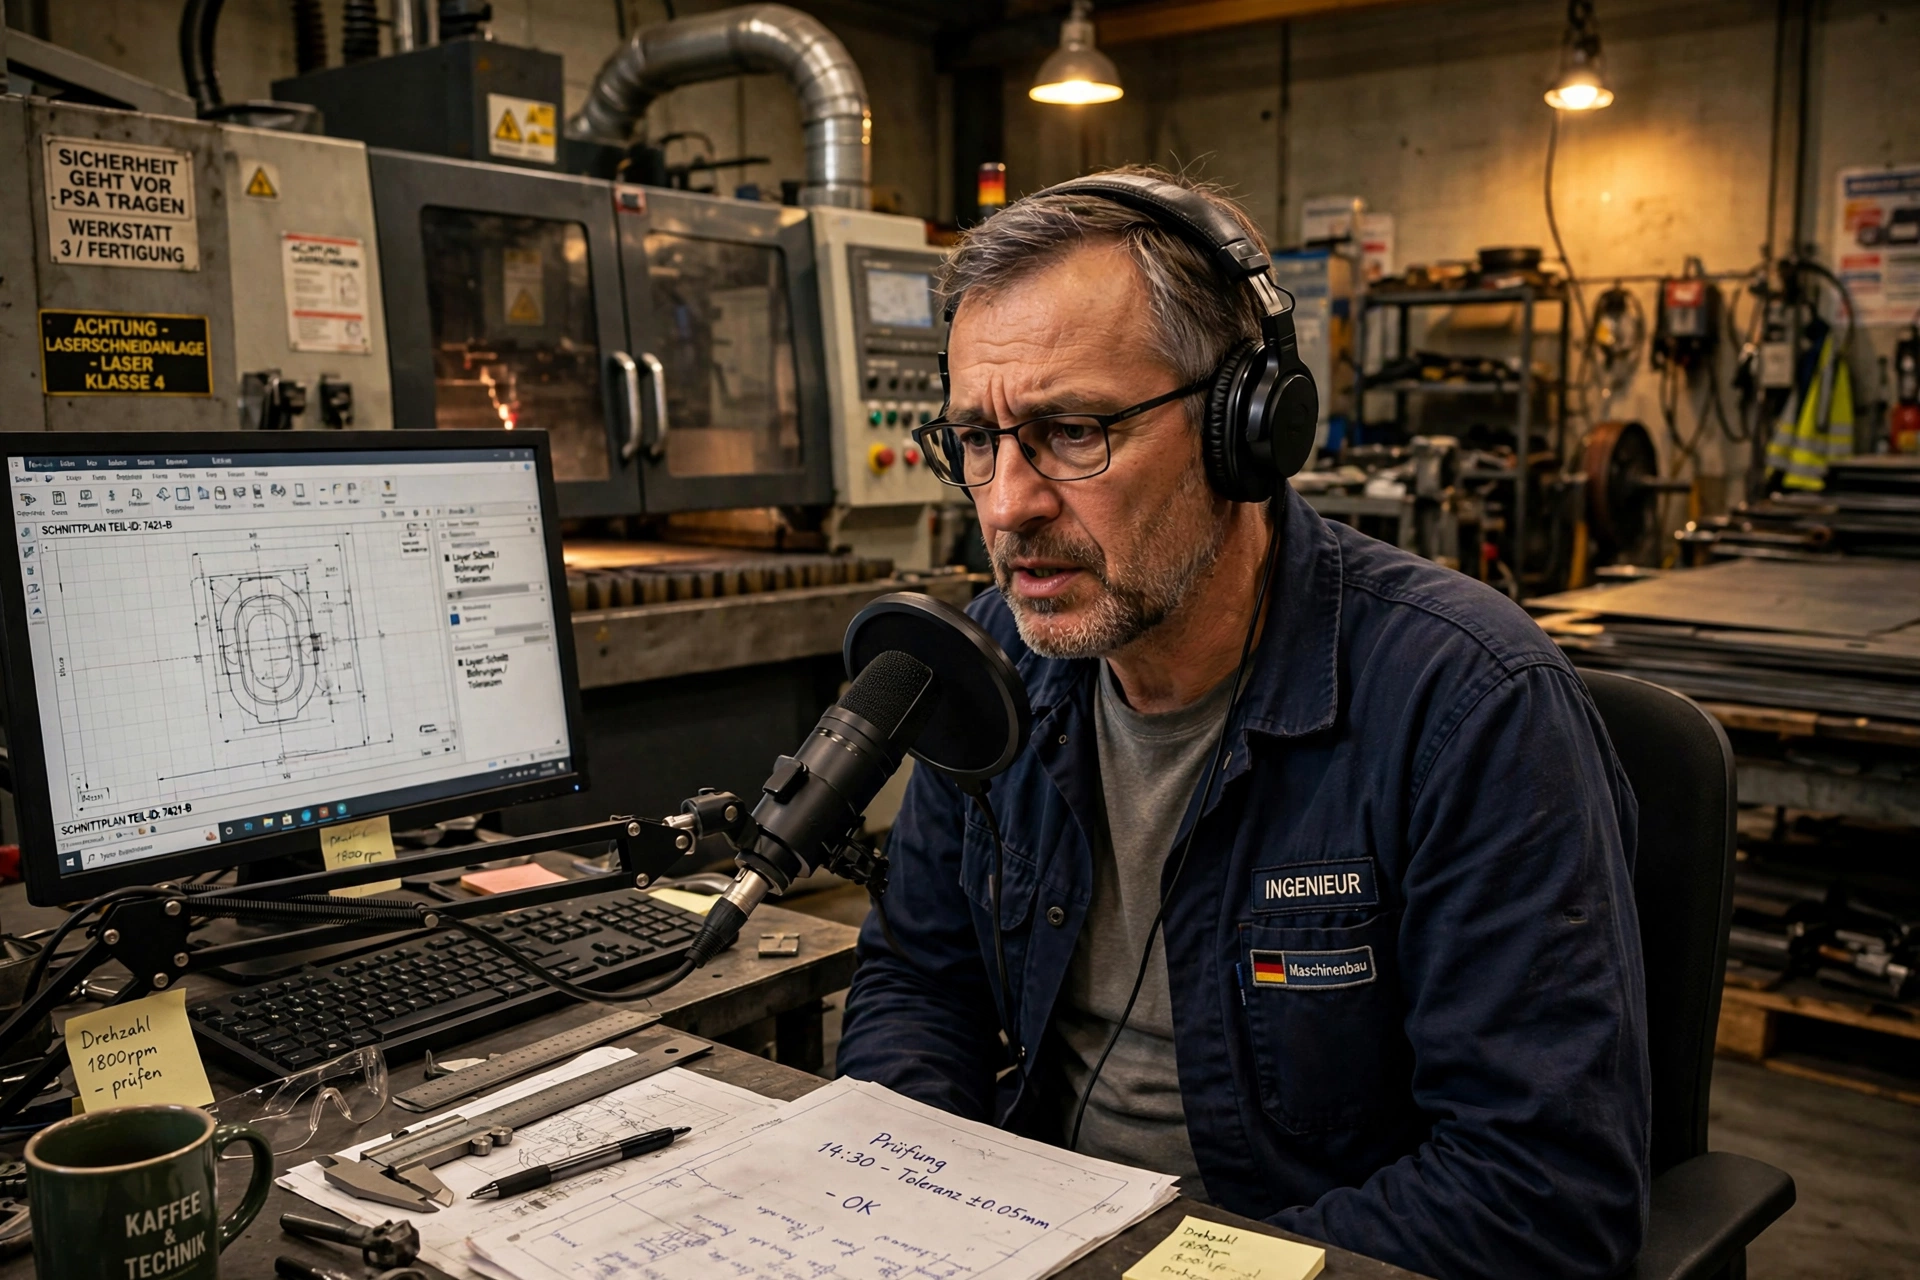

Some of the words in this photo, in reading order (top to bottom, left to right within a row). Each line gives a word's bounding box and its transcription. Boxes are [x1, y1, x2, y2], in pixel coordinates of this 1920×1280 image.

[59, 149, 178, 176] SICHERHEIT
[70, 170, 124, 190] GEHT
[130, 175, 171, 194] VOR
[60, 188, 100, 207] PSA
[105, 192, 184, 214] TRAGEN
[68, 218, 172, 242] WERKSTATT
[60, 239, 71, 256] 3
[76, 240, 83, 257] /
[88, 242, 184, 263] FERTIGUNG
[73, 317, 157, 337] ACHTUNG
[46, 337, 205, 356] LASERSCHNEIDANLAGE
[101, 355, 153, 372] LASER
[85, 373, 150, 390] KLASSE
[154, 375, 165, 390] 4
[42, 523, 106, 535] SCHNITTPLAN
[143, 520, 173, 531] 7421-B
[61, 815, 126, 835] SCHNITTPLAN
[1265, 873, 1361, 899] INGENIEUR
[1289, 961, 1367, 977] Maschinenbau
[81, 1015, 151, 1049] Drehzahl
[88, 1046, 157, 1073] 1800rpm
[112, 1067, 162, 1100] prüfen
[869, 1132, 947, 1173] Prüfung
[818, 1141, 875, 1168] 14:30
[898, 1167, 963, 1201] Toleranz
[965, 1194, 1050, 1230] ±0.05mm
[125, 1190, 201, 1238] KAFFEE
[842, 1196, 881, 1216] OK
[164, 1228, 176, 1245] &
[124, 1231, 206, 1280] TECHNIK
